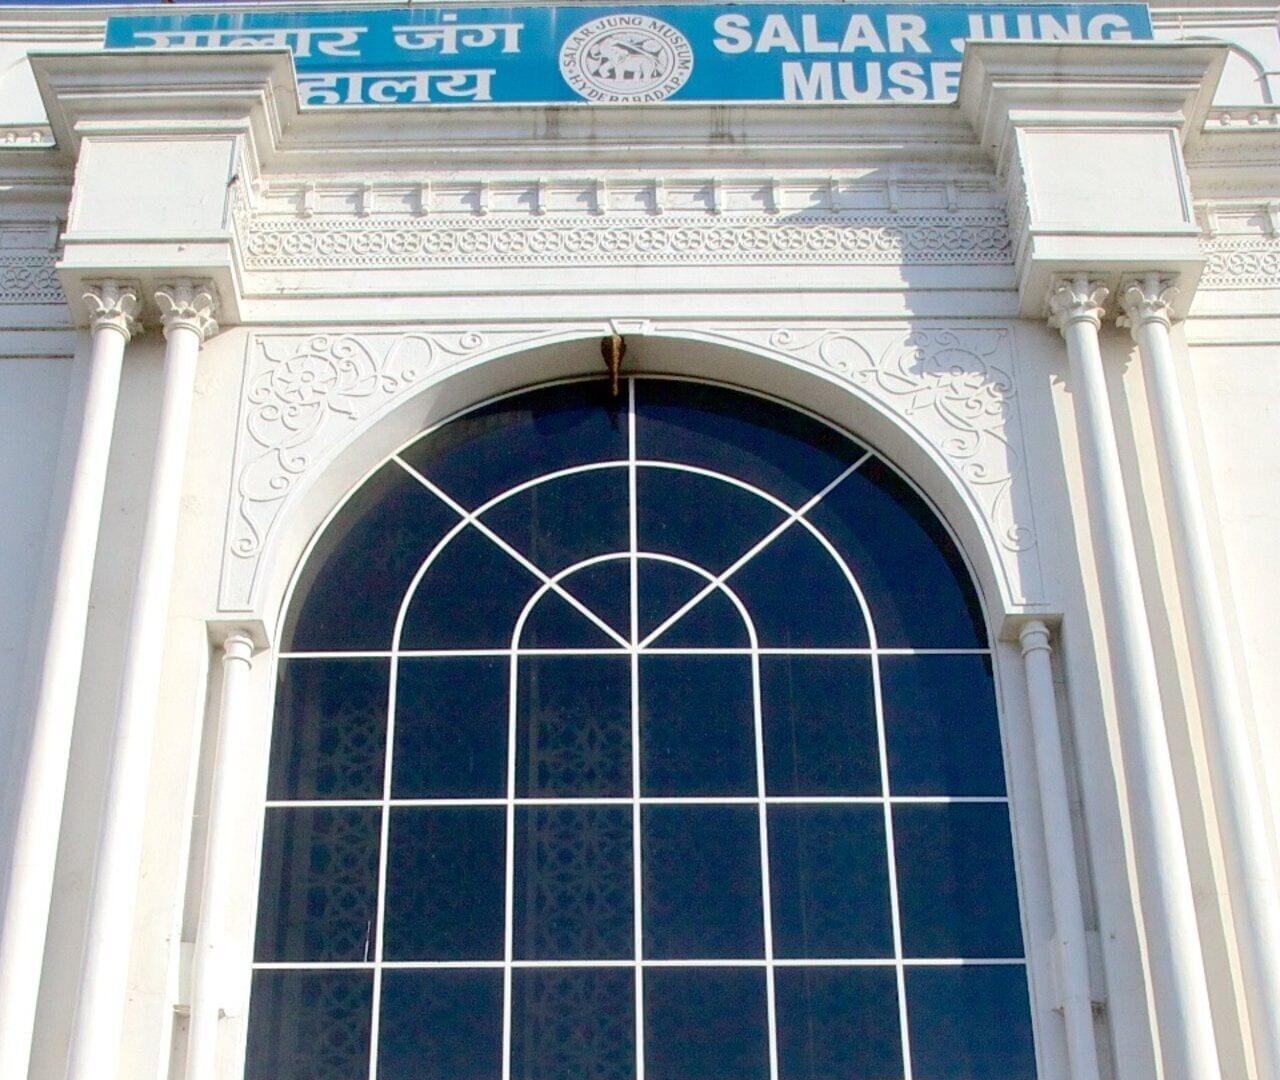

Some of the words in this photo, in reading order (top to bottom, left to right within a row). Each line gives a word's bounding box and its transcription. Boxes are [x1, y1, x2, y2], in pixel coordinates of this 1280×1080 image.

[392, 14, 524, 54] जंग
[563, 28, 595, 67] SALAR
[596, 17, 642, 29] JUNG
[648, 20, 691, 70] MUSEUM
[712, 13, 932, 53] SALAR
[951, 13, 1131, 52] JUNG
[297, 69, 496, 104] हालय
[783, 61, 963, 100] MUSE
